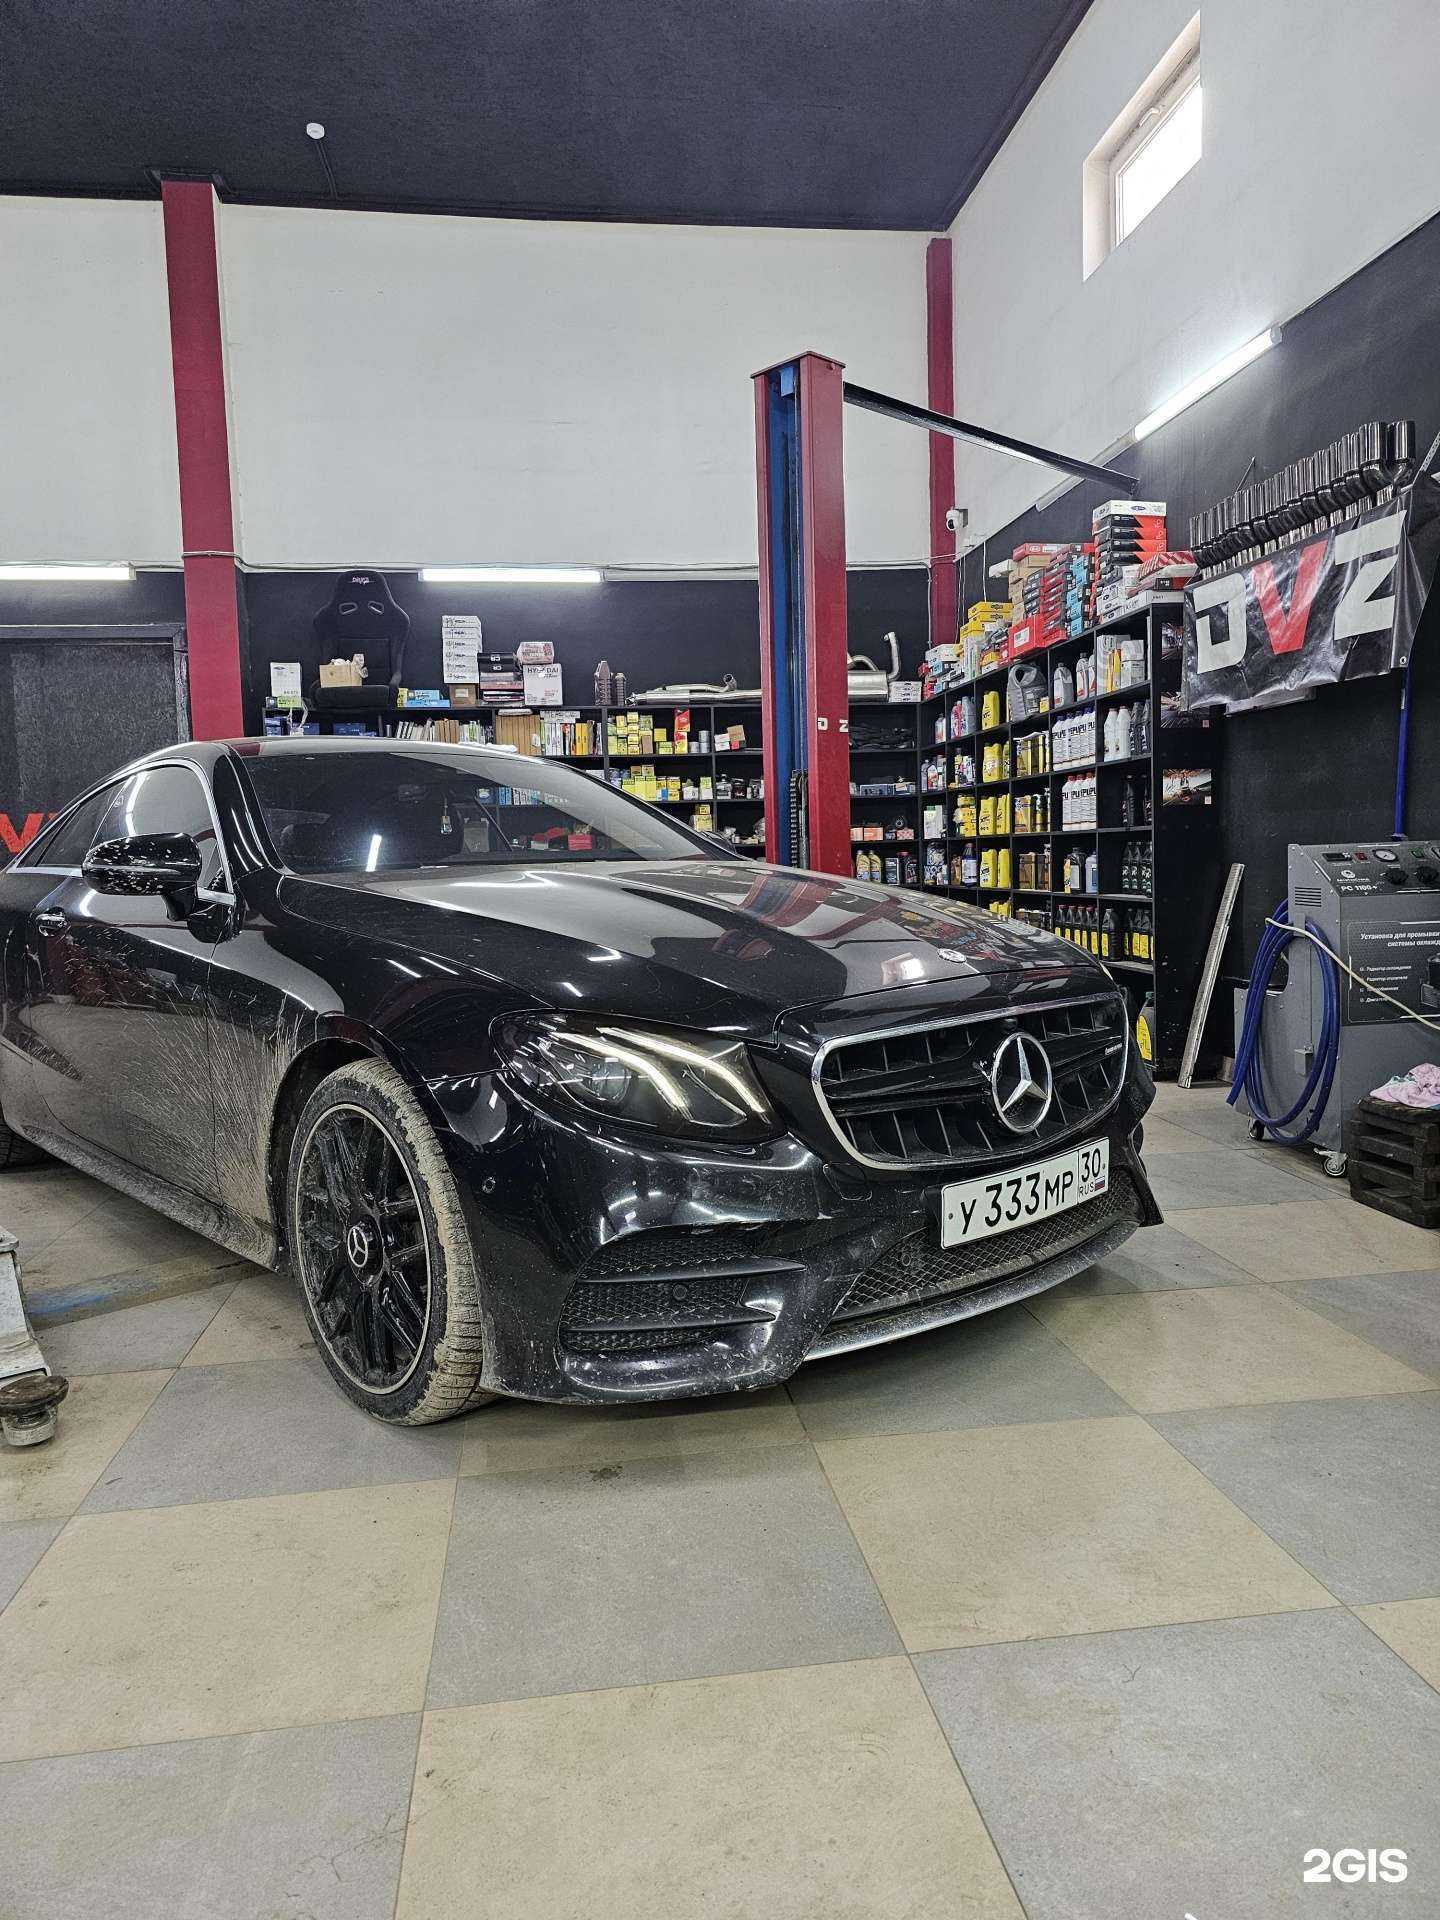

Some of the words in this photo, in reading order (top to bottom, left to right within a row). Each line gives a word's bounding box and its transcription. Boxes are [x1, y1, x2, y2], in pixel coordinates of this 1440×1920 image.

[1193, 510, 1408, 675] DVZ
[1080, 1147, 1101, 1183] 30
[1079, 1182, 1095, 1198] RUS
